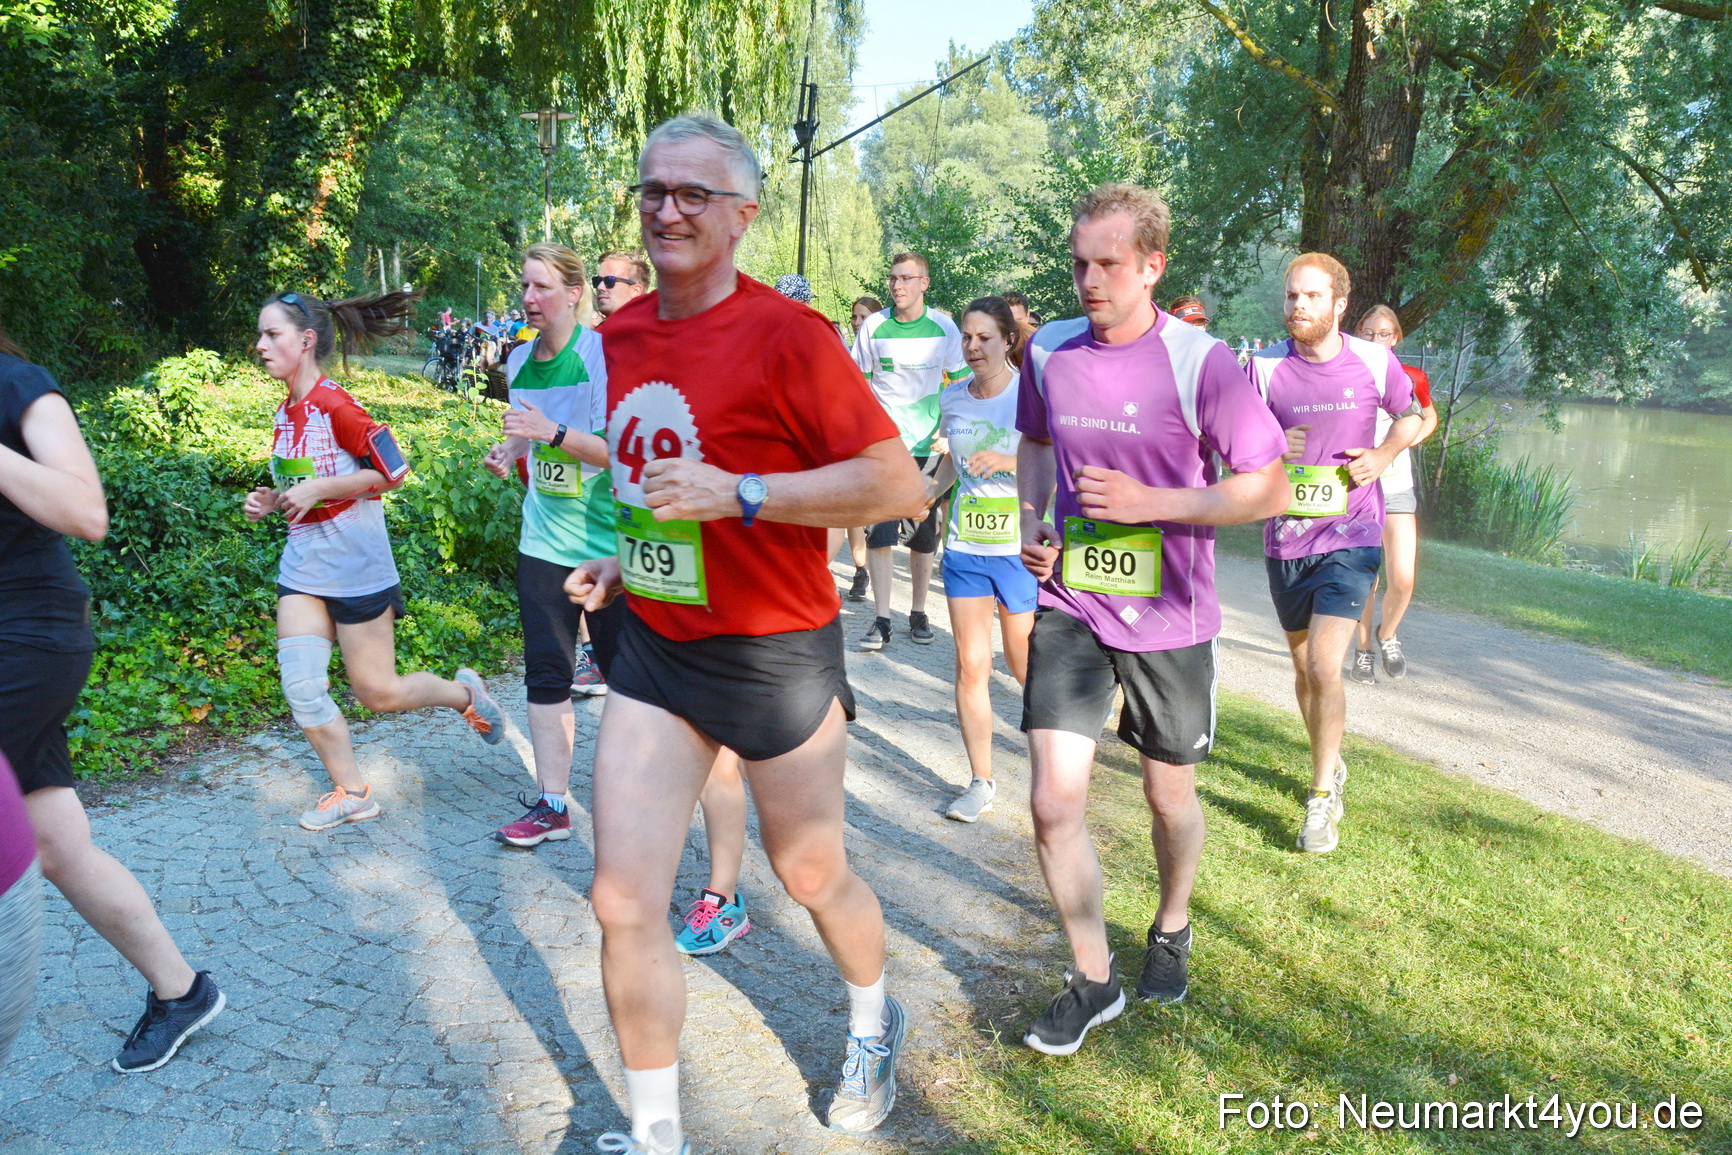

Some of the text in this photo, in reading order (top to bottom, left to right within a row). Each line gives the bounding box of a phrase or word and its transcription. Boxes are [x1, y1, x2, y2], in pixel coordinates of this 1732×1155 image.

[1292, 401, 1359, 414] WIR SIND LILA.
[1059, 414, 1141, 435] WIR SIND LILA.
[537, 460, 565, 482] 102
[1295, 483, 1333, 502] 679
[965, 512, 1010, 530] 1037
[625, 536, 675, 576] 769
[1084, 546, 1136, 576] 690
[1085, 571, 1136, 585] Reim Matthias
